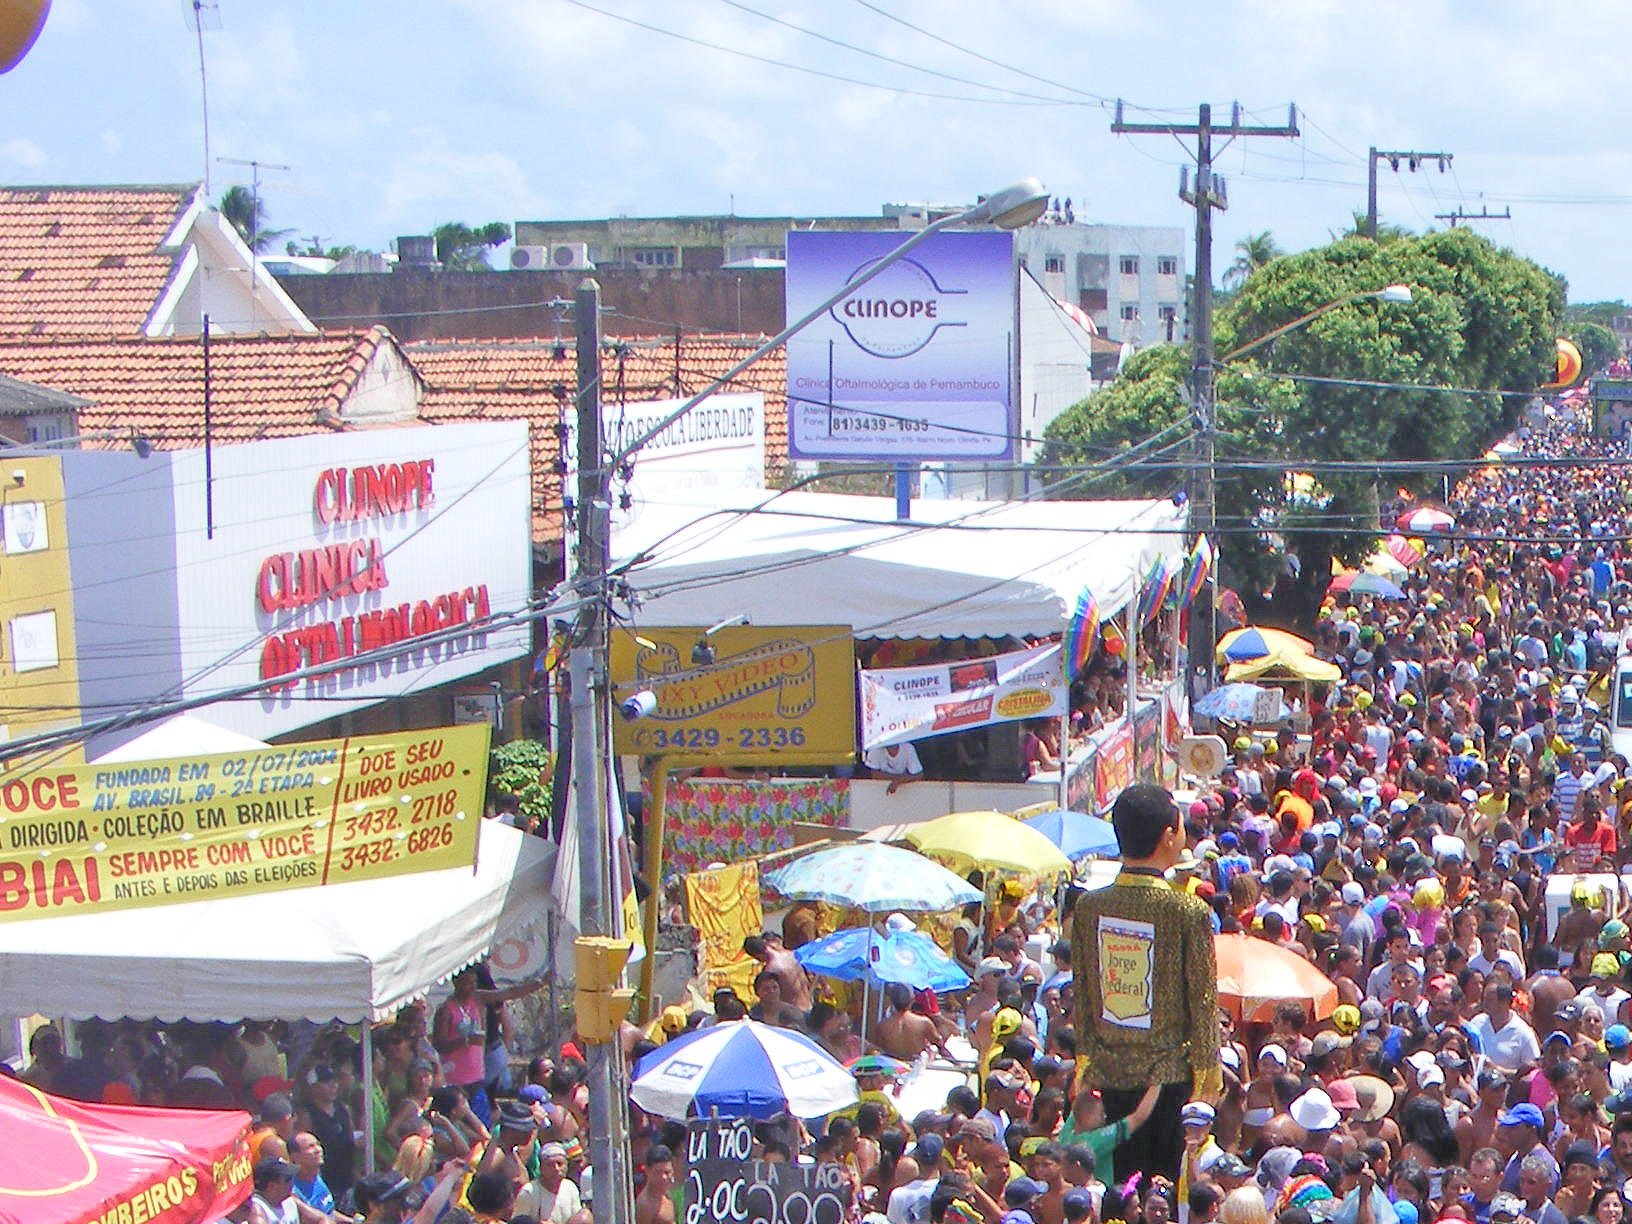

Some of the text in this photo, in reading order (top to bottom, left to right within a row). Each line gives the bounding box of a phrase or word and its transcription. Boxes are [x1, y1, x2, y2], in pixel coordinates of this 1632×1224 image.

[844, 299, 937, 318] CLINOPE
[687, 407, 755, 441] LIBERDADE
[316, 459, 436, 525] CLINOPE
[713, 653, 799, 694] VIDEO
[893, 675, 941, 692] CLINOPE
[95, 748, 338, 790] FUNDADA EM 02/07/2004
[360, 739, 444, 777] DOE SEU
[1, 773, 80, 813] OCE
[93, 792, 121, 812] AV.
[258, 773, 314, 795] ETAPA
[343, 760, 455, 804] LIVRO USADO
[411, 789, 457, 824] 2718
[10, 820, 89, 848] DIRIGIDA
[103, 807, 185, 840] COLEÇÃO
[196, 808, 227, 830] EM
[407, 823, 453, 855] 6826
[109, 825, 316, 878] SEMPRE COM VOCÊ
[114, 861, 318, 899] ANTES E DEPOIS DAS ELEIÇÕES
[1107, 951, 1137, 975] Jorge
[1106, 976, 1144, 997] ederal
[688, 1117, 752, 1164] LA TÃO
[754, 1160, 780, 1185] LA
